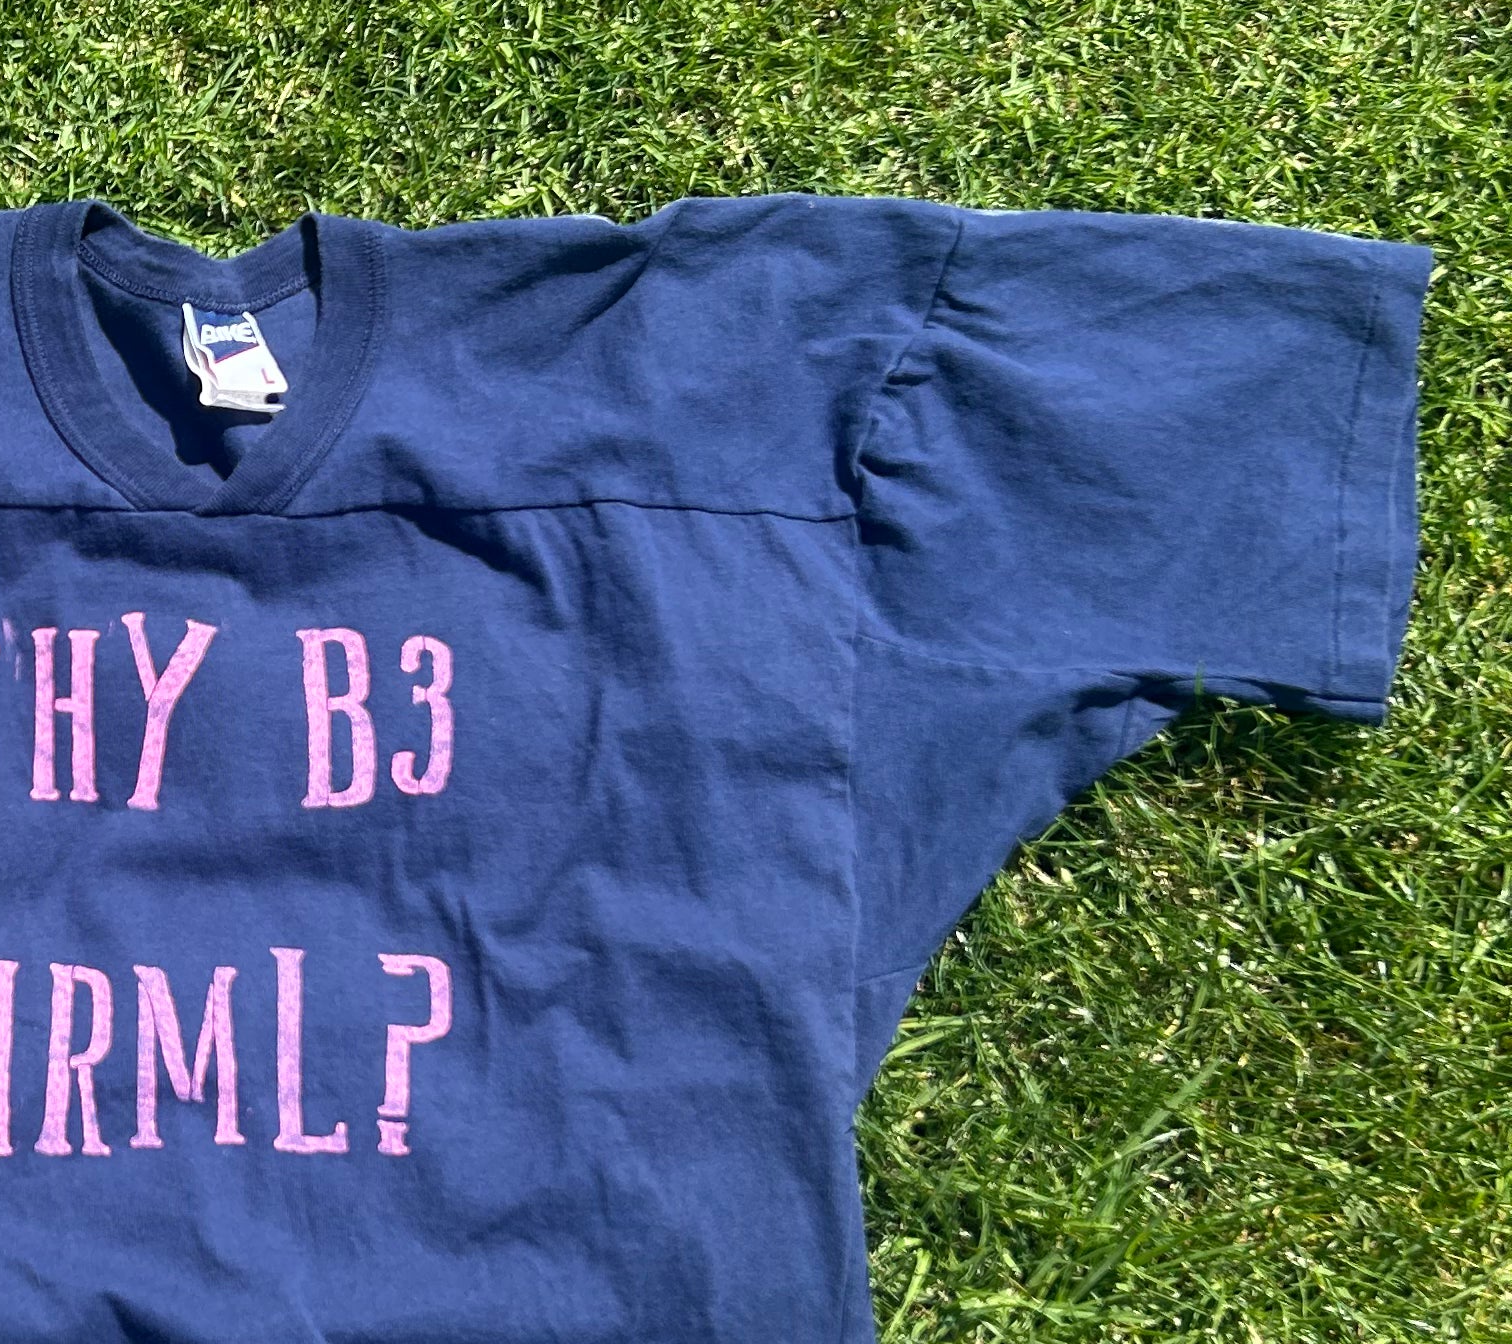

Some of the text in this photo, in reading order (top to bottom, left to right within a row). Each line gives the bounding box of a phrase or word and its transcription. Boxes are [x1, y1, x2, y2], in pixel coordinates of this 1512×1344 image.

[200, 321, 257, 345] BIKE
[261, 367, 275, 384] L
[295, 627, 454, 809] B3
